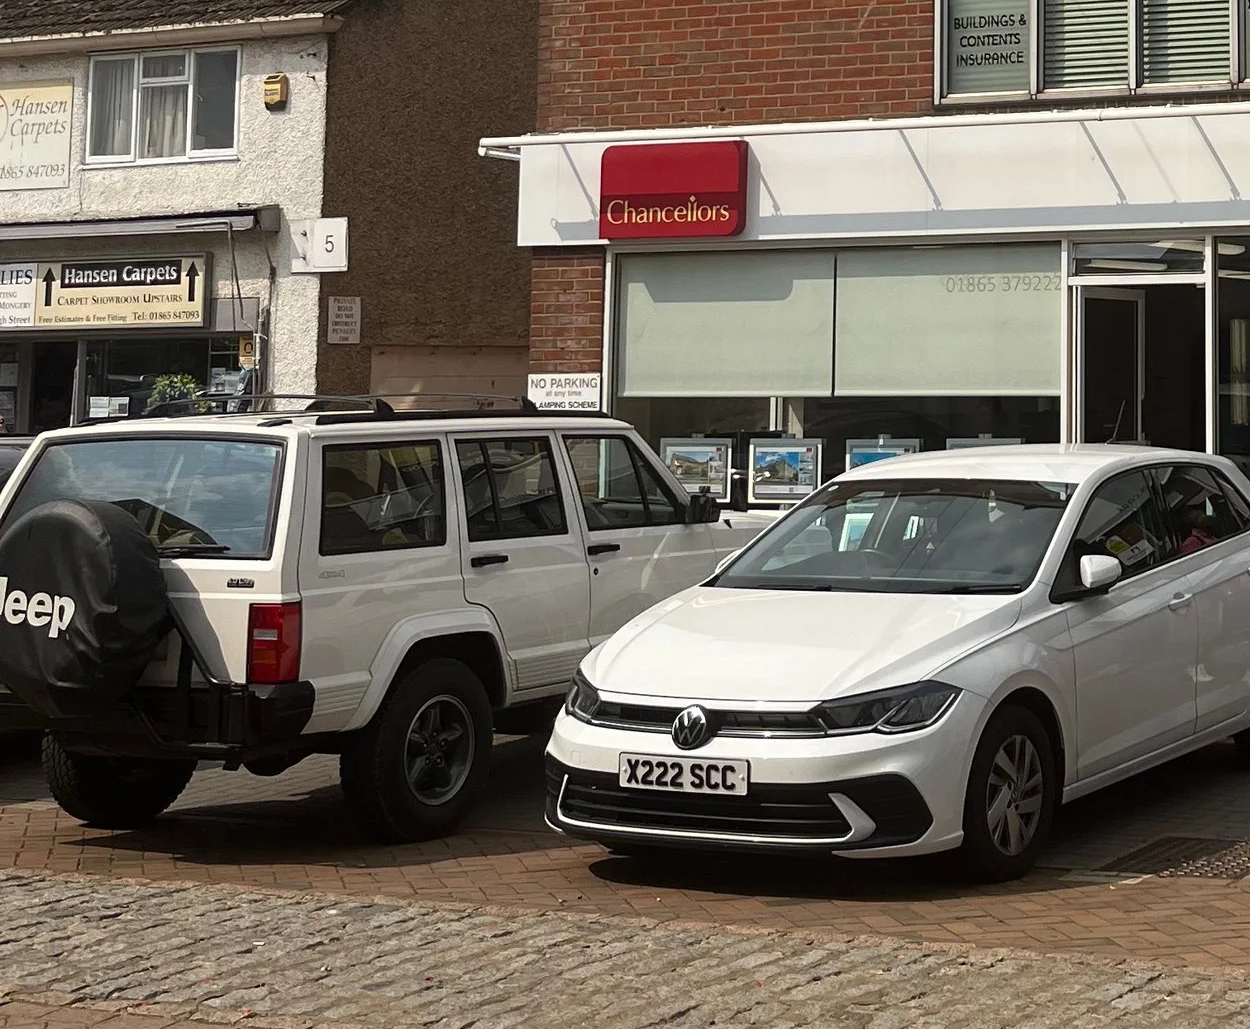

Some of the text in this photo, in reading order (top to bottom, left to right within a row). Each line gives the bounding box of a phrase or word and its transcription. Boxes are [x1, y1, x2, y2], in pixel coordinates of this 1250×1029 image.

[954, 13, 1027, 30] BUILDINGS &
[959, 33, 1021, 48] CONTENTS
[956, 51, 1025, 67] INSURANCE
[10, 95, 68, 117] Hansen
[10, 119, 68, 144] Carpets
[26, 163, 66, 178] 847093
[606, 195, 730, 225] Chancellors
[324, 235, 335, 253] 5
[64, 265, 178, 285] Hansen Carpets
[945, 274, 1062, 293] 01865 379222
[8, 315, 31, 324] Street
[132, 311, 147, 321] Tel:
[148, 311, 172, 321] 01865
[530, 377, 598, 389] NO PARKING
[553, 390, 566, 398] any
[537, 401, 598, 409] AMPING SCHEME
[625, 758, 737, 791] X222 SCC
